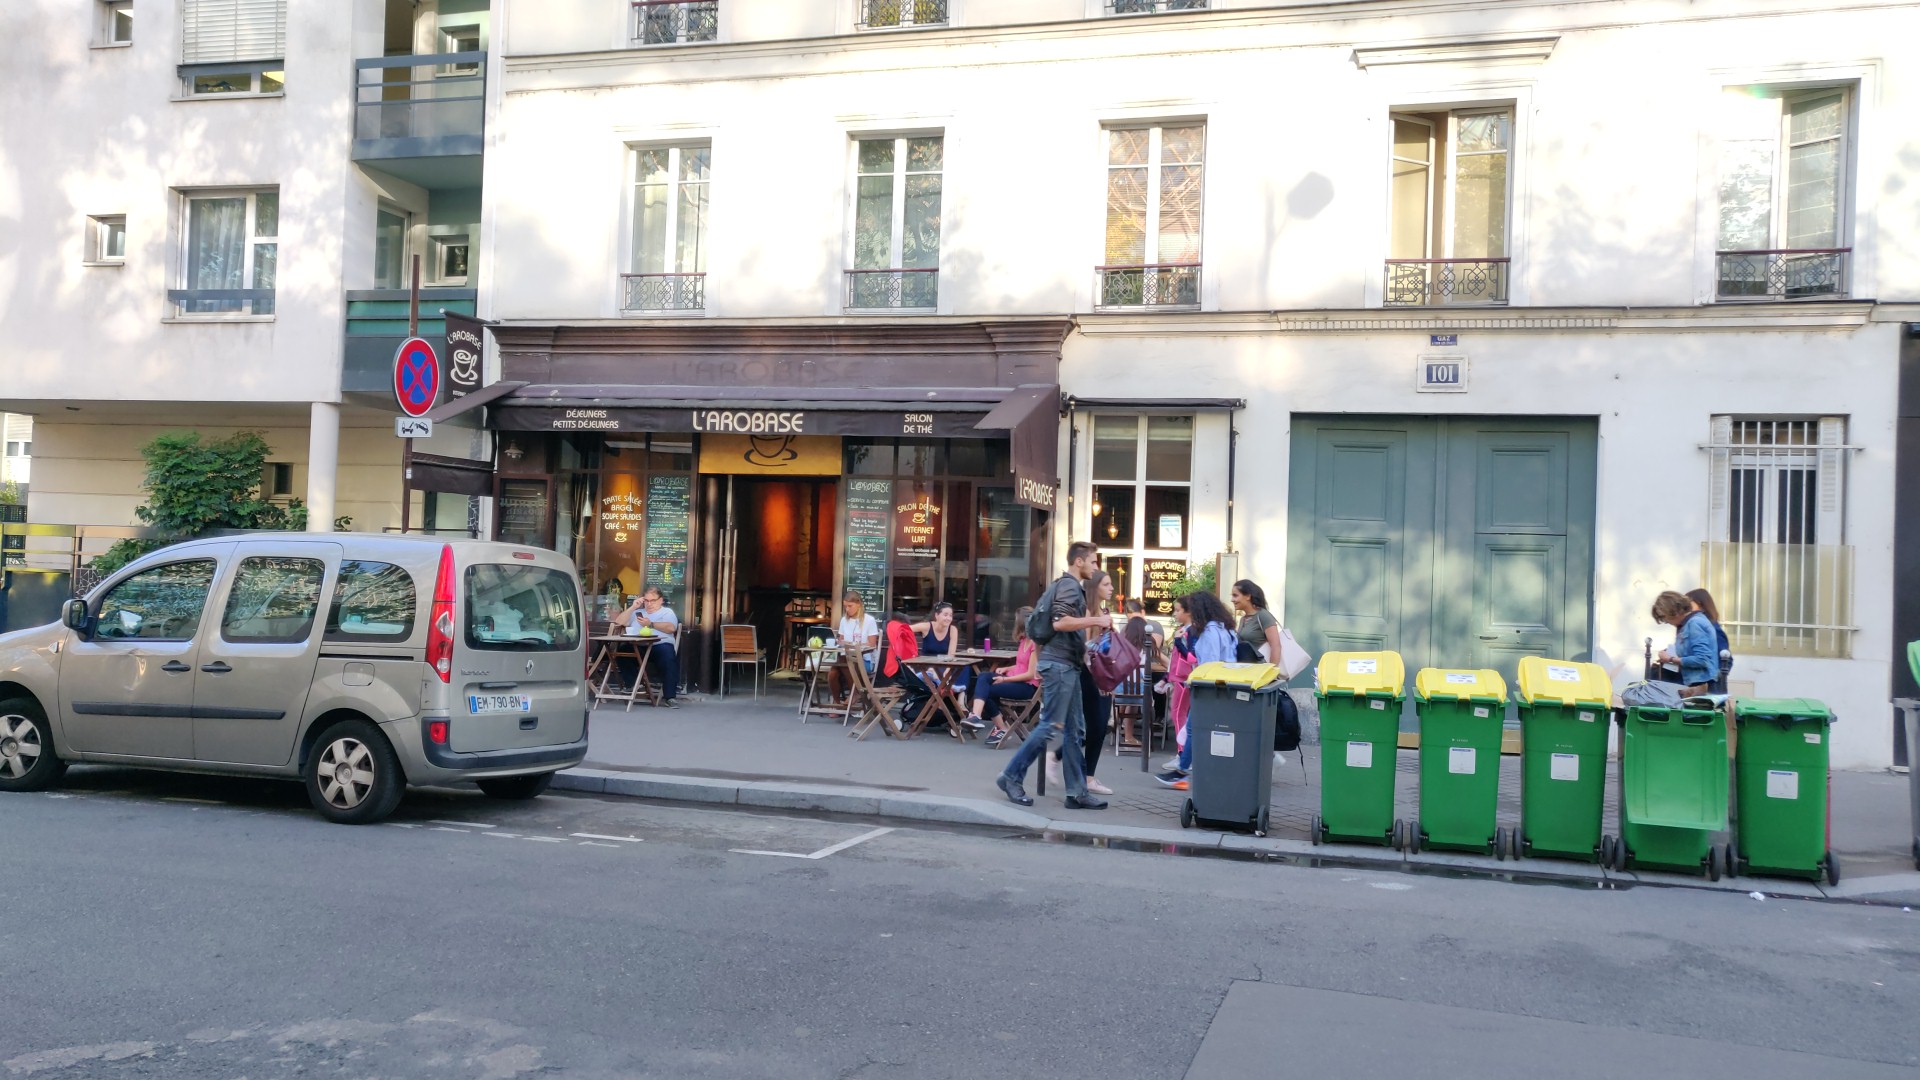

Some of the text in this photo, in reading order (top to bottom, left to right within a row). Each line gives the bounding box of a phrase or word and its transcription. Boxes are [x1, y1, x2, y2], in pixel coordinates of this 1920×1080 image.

[447, 330, 482, 350] L'AROBASE
[1431, 365, 1454, 382] 101
[566, 409, 607, 418] DÉJEUNERS
[904, 414, 933, 423] SALON
[552, 419, 619, 429] PETITS DÉJEUNERS
[692, 411, 803, 433] L'AROBASE
[903, 423, 933, 434] DE THÉ
[1020, 477, 1053, 506] L'AROBASE
[611, 504, 633, 512] BAGEL
[897, 503, 917, 513] SALON
[918, 503, 928, 511] DE
[601, 512, 642, 521] SOUPE SALADES
[604, 522, 620, 530] CAFÉ
[626, 522, 639, 530] THÉ
[903, 526, 935, 534] INTERNET
[911, 535, 926, 543] WIFI
[1151, 561, 1186, 573] EMPORTER
[477, 696, 521, 709] EM-790-BN
